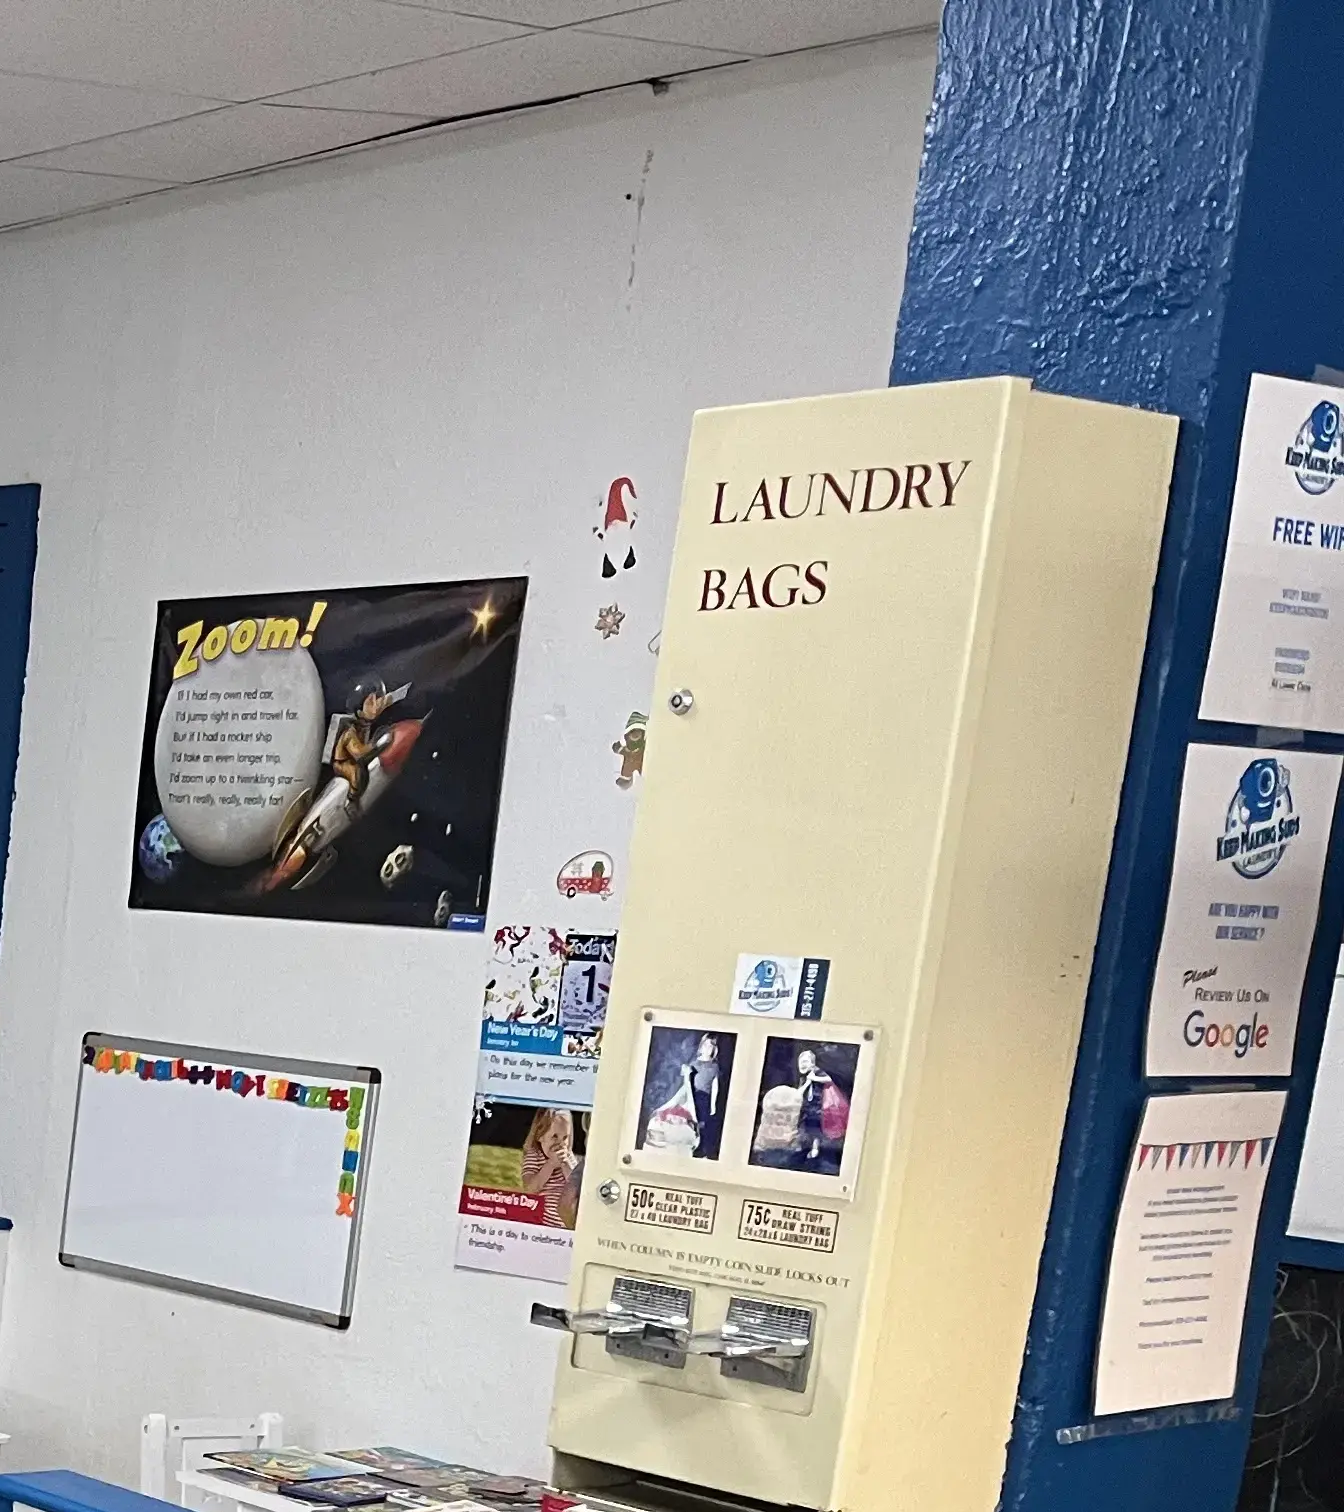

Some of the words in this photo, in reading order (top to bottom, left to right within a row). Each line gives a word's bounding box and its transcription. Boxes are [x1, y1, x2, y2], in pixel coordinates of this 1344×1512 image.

[709, 460, 972, 525] LAUNDRY
[1273, 517, 1315, 546] FREE
[697, 561, 829, 612] BAGS
[173, 601, 328, 680] Zoom!
[192, 690, 208, 700] had
[209, 691, 221, 702] my
[223, 691, 241, 700] own
[244, 689, 257, 700] red
[187, 711, 208, 723] jump
[211, 711, 229, 724] right
[232, 711, 239, 720] in
[241, 711, 257, 720] and
[260, 710, 283, 720] travel
[203, 732, 218, 742] had
[228, 732, 253, 742] rocket
[256, 732, 272, 743] ship
[184, 753, 200, 762] take
[237, 753, 263, 765] longer
[182, 775, 203, 783] zoom
[206, 775, 216, 785] up
[219, 774, 227, 783] to
[237, 774, 275, 787] twinkling
[244, 794, 266, 807] really
[582, 965, 596, 1003] 1
[1183, 966, 1218, 988] Please
[487, 1021, 508, 1035] New
[510, 1024, 538, 1037] Year's
[539, 1027, 558, 1041] Day
[1183, 1009, 1269, 1058] Google
[503, 1057, 517, 1066] this
[520, 1058, 533, 1068] day
[549, 1062, 590, 1072] remember
[488, 1070, 508, 1080] plans
[511, 1071, 522, 1080] for
[525, 1073, 537, 1082] the
[467, 1187, 519, 1206] Valentine's
[520, 1195, 539, 1211] Day
[665, 1192, 683, 1203] REAL
[655, 1201, 678, 1213] CLEAR
[680, 1205, 711, 1218] PLASTIC
[782, 1209, 802, 1221] REAL
[659, 1213, 692, 1226] LAUNDRY
[694, 1218, 709, 1229] BAG
[771, 1219, 797, 1231] DRAW
[799, 1223, 831, 1236] STRING
[471, 1223, 487, 1235] This
[489, 1227, 495, 1235] is
[506, 1230, 518, 1240] day
[521, 1232, 528, 1240] to
[531, 1233, 567, 1247] celebrate
[779, 1231, 813, 1245] LAUNDRY
[597, 1236, 627, 1250] WHEN
[629, 1243, 673, 1258] COLUMN
[675, 1251, 686, 1261] IS
[688, 1253, 721, 1267] EMPTY
[724, 1259, 752, 1273] COIN
[755, 1264, 781, 1276] SLIDE
[785, 1269, 823, 1283] LOCKS
[825, 1276, 850, 1288] OUT
